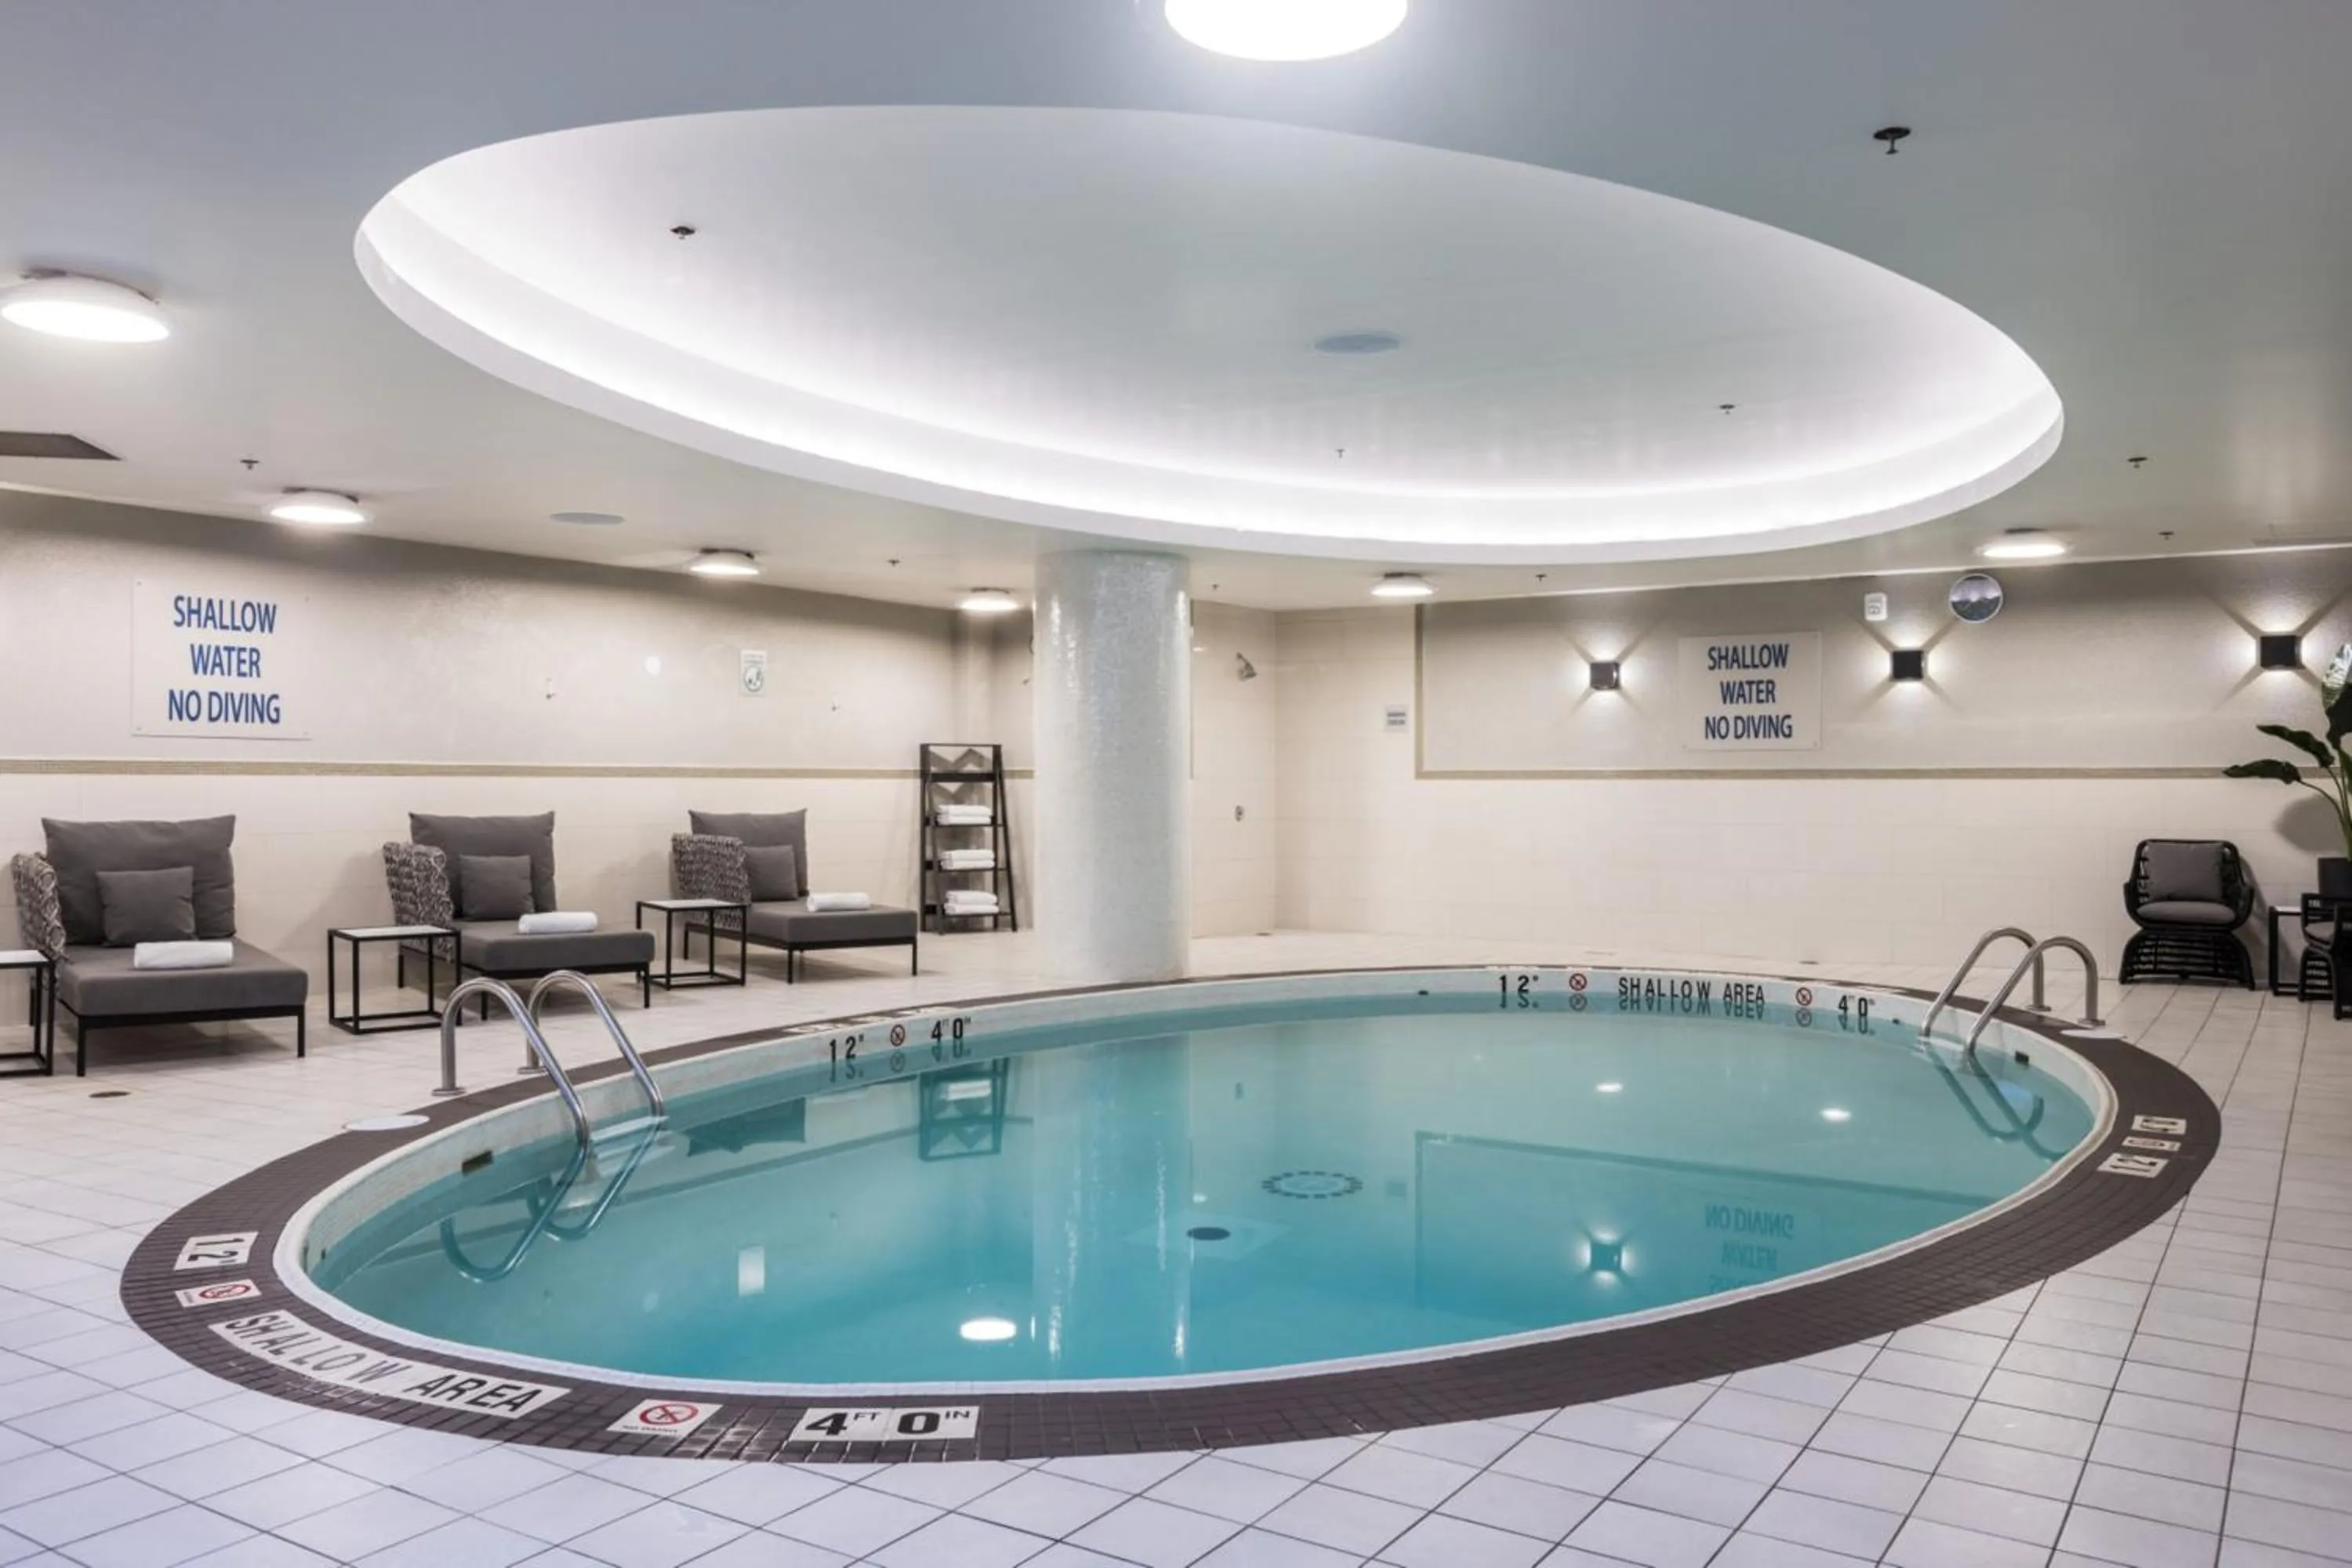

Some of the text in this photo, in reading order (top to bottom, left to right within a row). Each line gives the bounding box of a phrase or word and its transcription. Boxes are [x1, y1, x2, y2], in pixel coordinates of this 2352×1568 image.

[172, 595, 277, 633] SHALLOW
[190, 644, 261, 678] WATER
[1708, 644, 1790, 670] SHALLOW
[168, 689, 281, 724] NO DIVING
[1720, 679, 1776, 705] WATER
[1704, 714, 1792, 740] NO DIVING
[1618, 977, 1764, 1003] SHALLOW AREA
[225, 1315, 543, 1413] SHALLOW AREA
